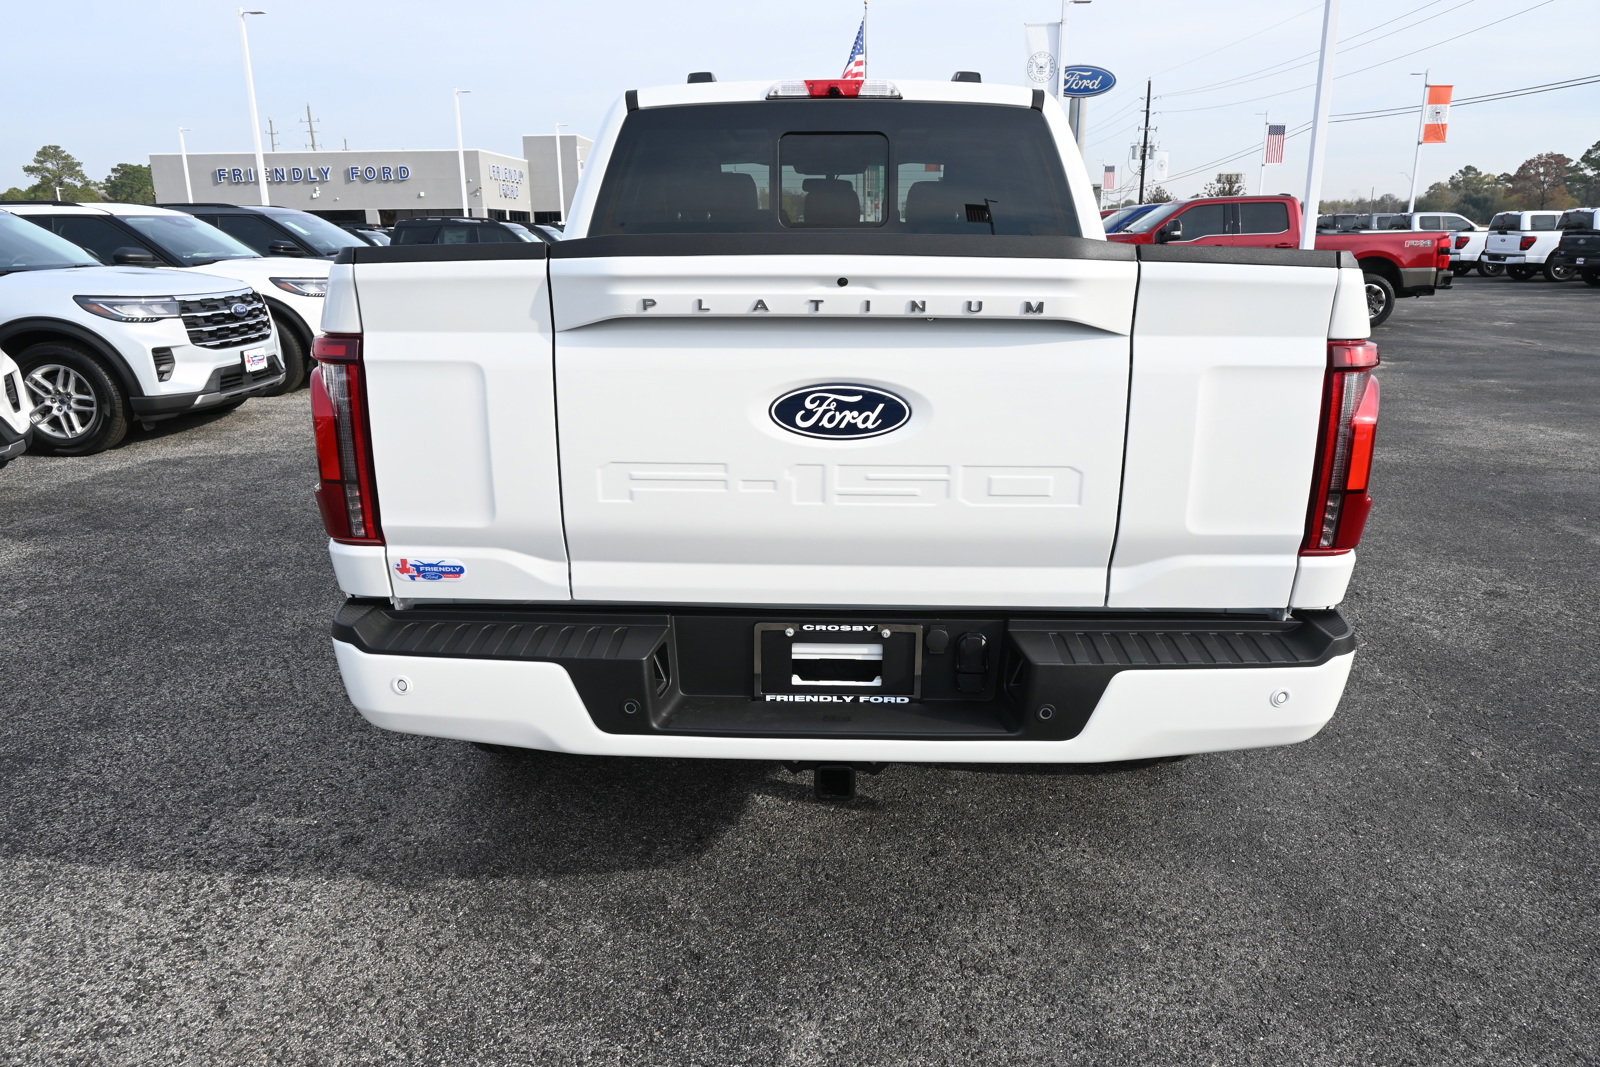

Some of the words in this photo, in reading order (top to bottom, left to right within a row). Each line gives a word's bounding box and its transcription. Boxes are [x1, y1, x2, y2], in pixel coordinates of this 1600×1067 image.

[1064, 70, 1103, 90] Ford
[349, 165, 411, 181] FORD
[641, 298, 1046, 314] PLATINUM
[795, 392, 885, 430] Ford
[596, 460, 1084, 507] F-150
[802, 624, 876, 632] CROSBY
[765, 694, 855, 703] FRIENDLY
[859, 696, 910, 704] FORD
